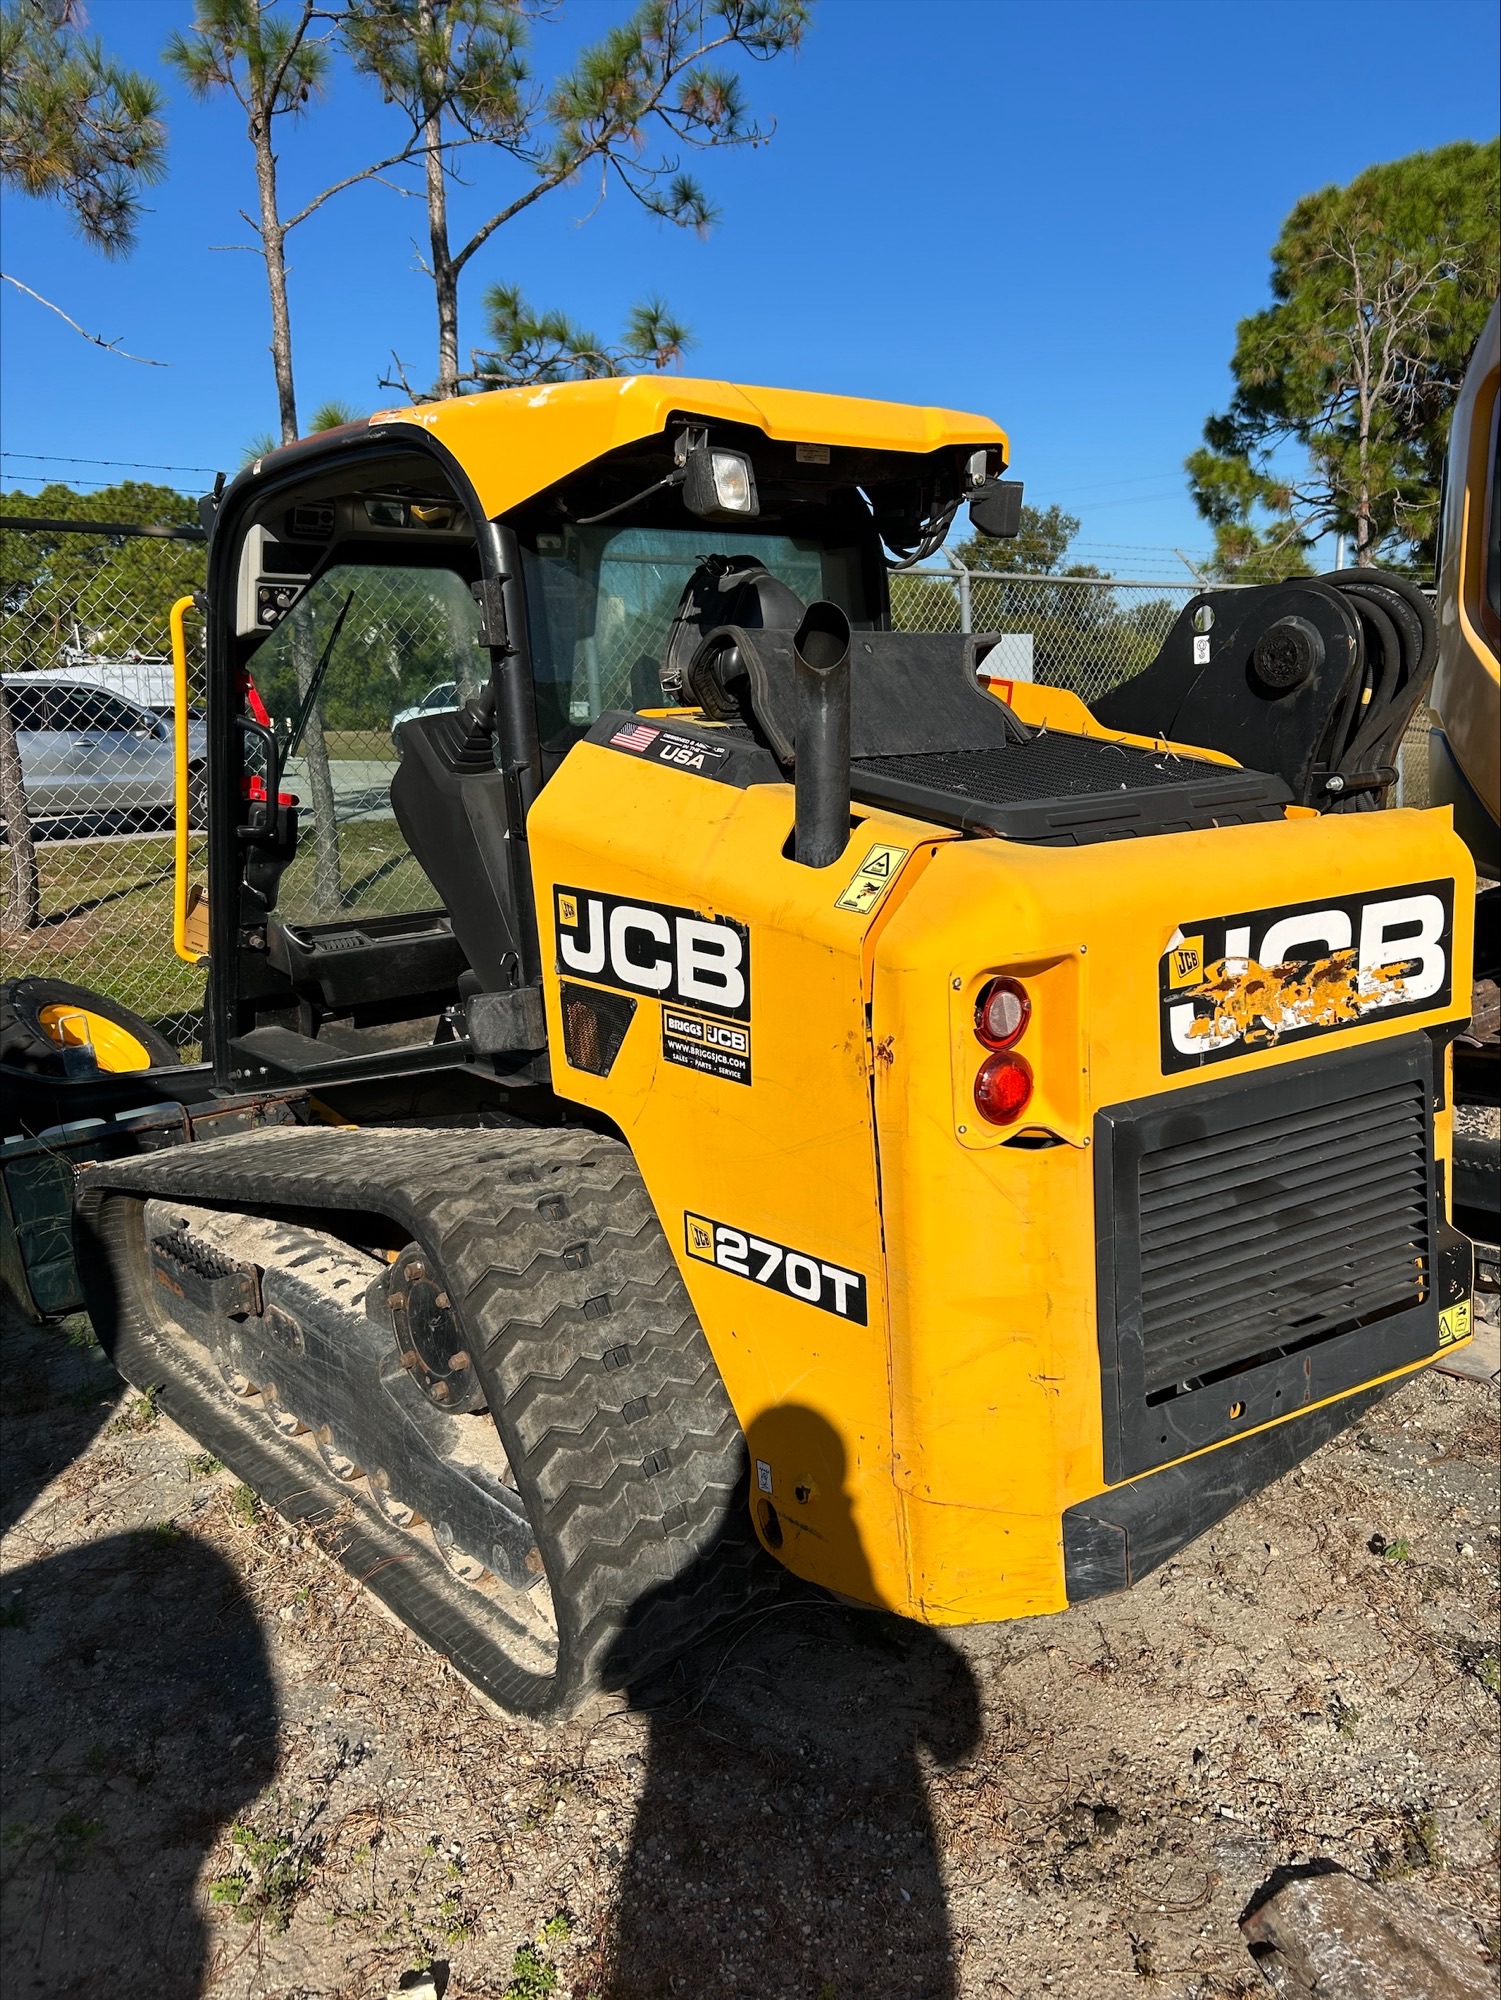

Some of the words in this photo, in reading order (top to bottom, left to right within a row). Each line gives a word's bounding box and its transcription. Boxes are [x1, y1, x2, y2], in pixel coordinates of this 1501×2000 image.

[663, 733, 690, 744] DESIGNED
[660, 744, 705, 770] USA
[560, 899, 745, 1009] JCB
[1178, 951, 1198, 975] JCB
[1169, 894, 1445, 1055] JCB
[668, 1018, 702, 1036] BRIGGS
[707, 1026, 745, 1051] JCB
[667, 1040, 746, 1070] WWW.BRIGGSJCB.COM
[672, 1053, 688, 1063] SALES
[695, 1060, 712, 1070] PARTS
[719, 1067, 741, 1079] SERVICE
[694, 1227, 710, 1246] JCB
[716, 1227, 859, 1315] 270T
